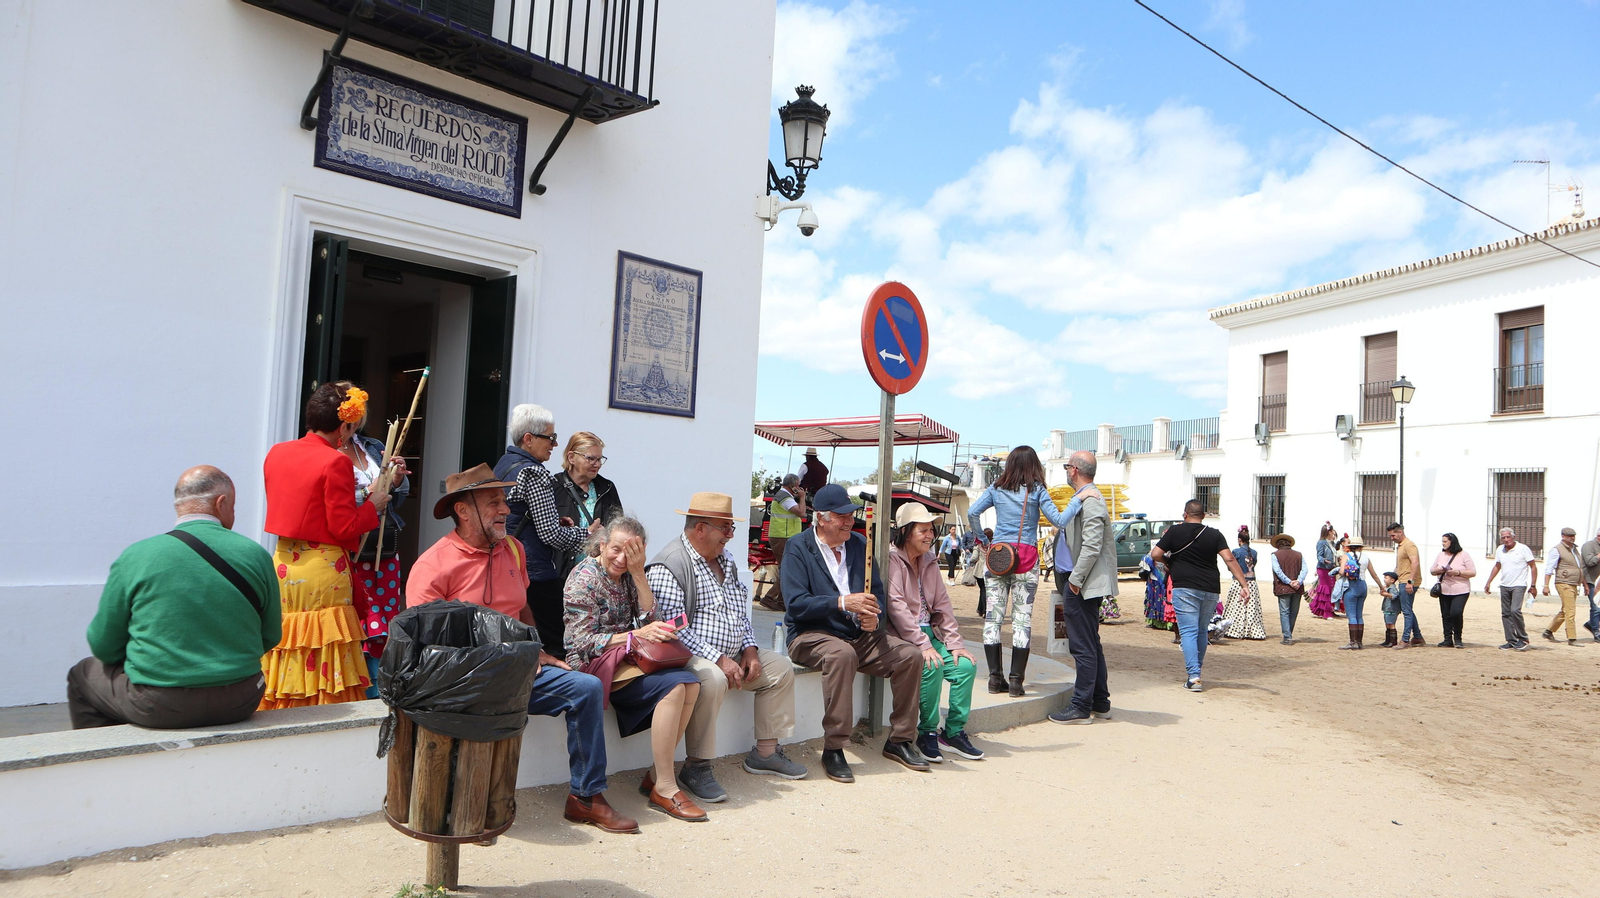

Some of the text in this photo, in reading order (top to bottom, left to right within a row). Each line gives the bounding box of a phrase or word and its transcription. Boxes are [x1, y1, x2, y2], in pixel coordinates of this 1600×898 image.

[374, 93, 482, 146] RECUERDOS
[342, 110, 358, 137] de
[359, 114, 371, 141] la
[402, 125, 438, 163] Virgen
[441, 140, 459, 166] del
[462, 143, 506, 178] ROCIO
[430, 161, 495, 188] DESPACHO OFICIAL
[645, 292, 676, 304] CAMINO
